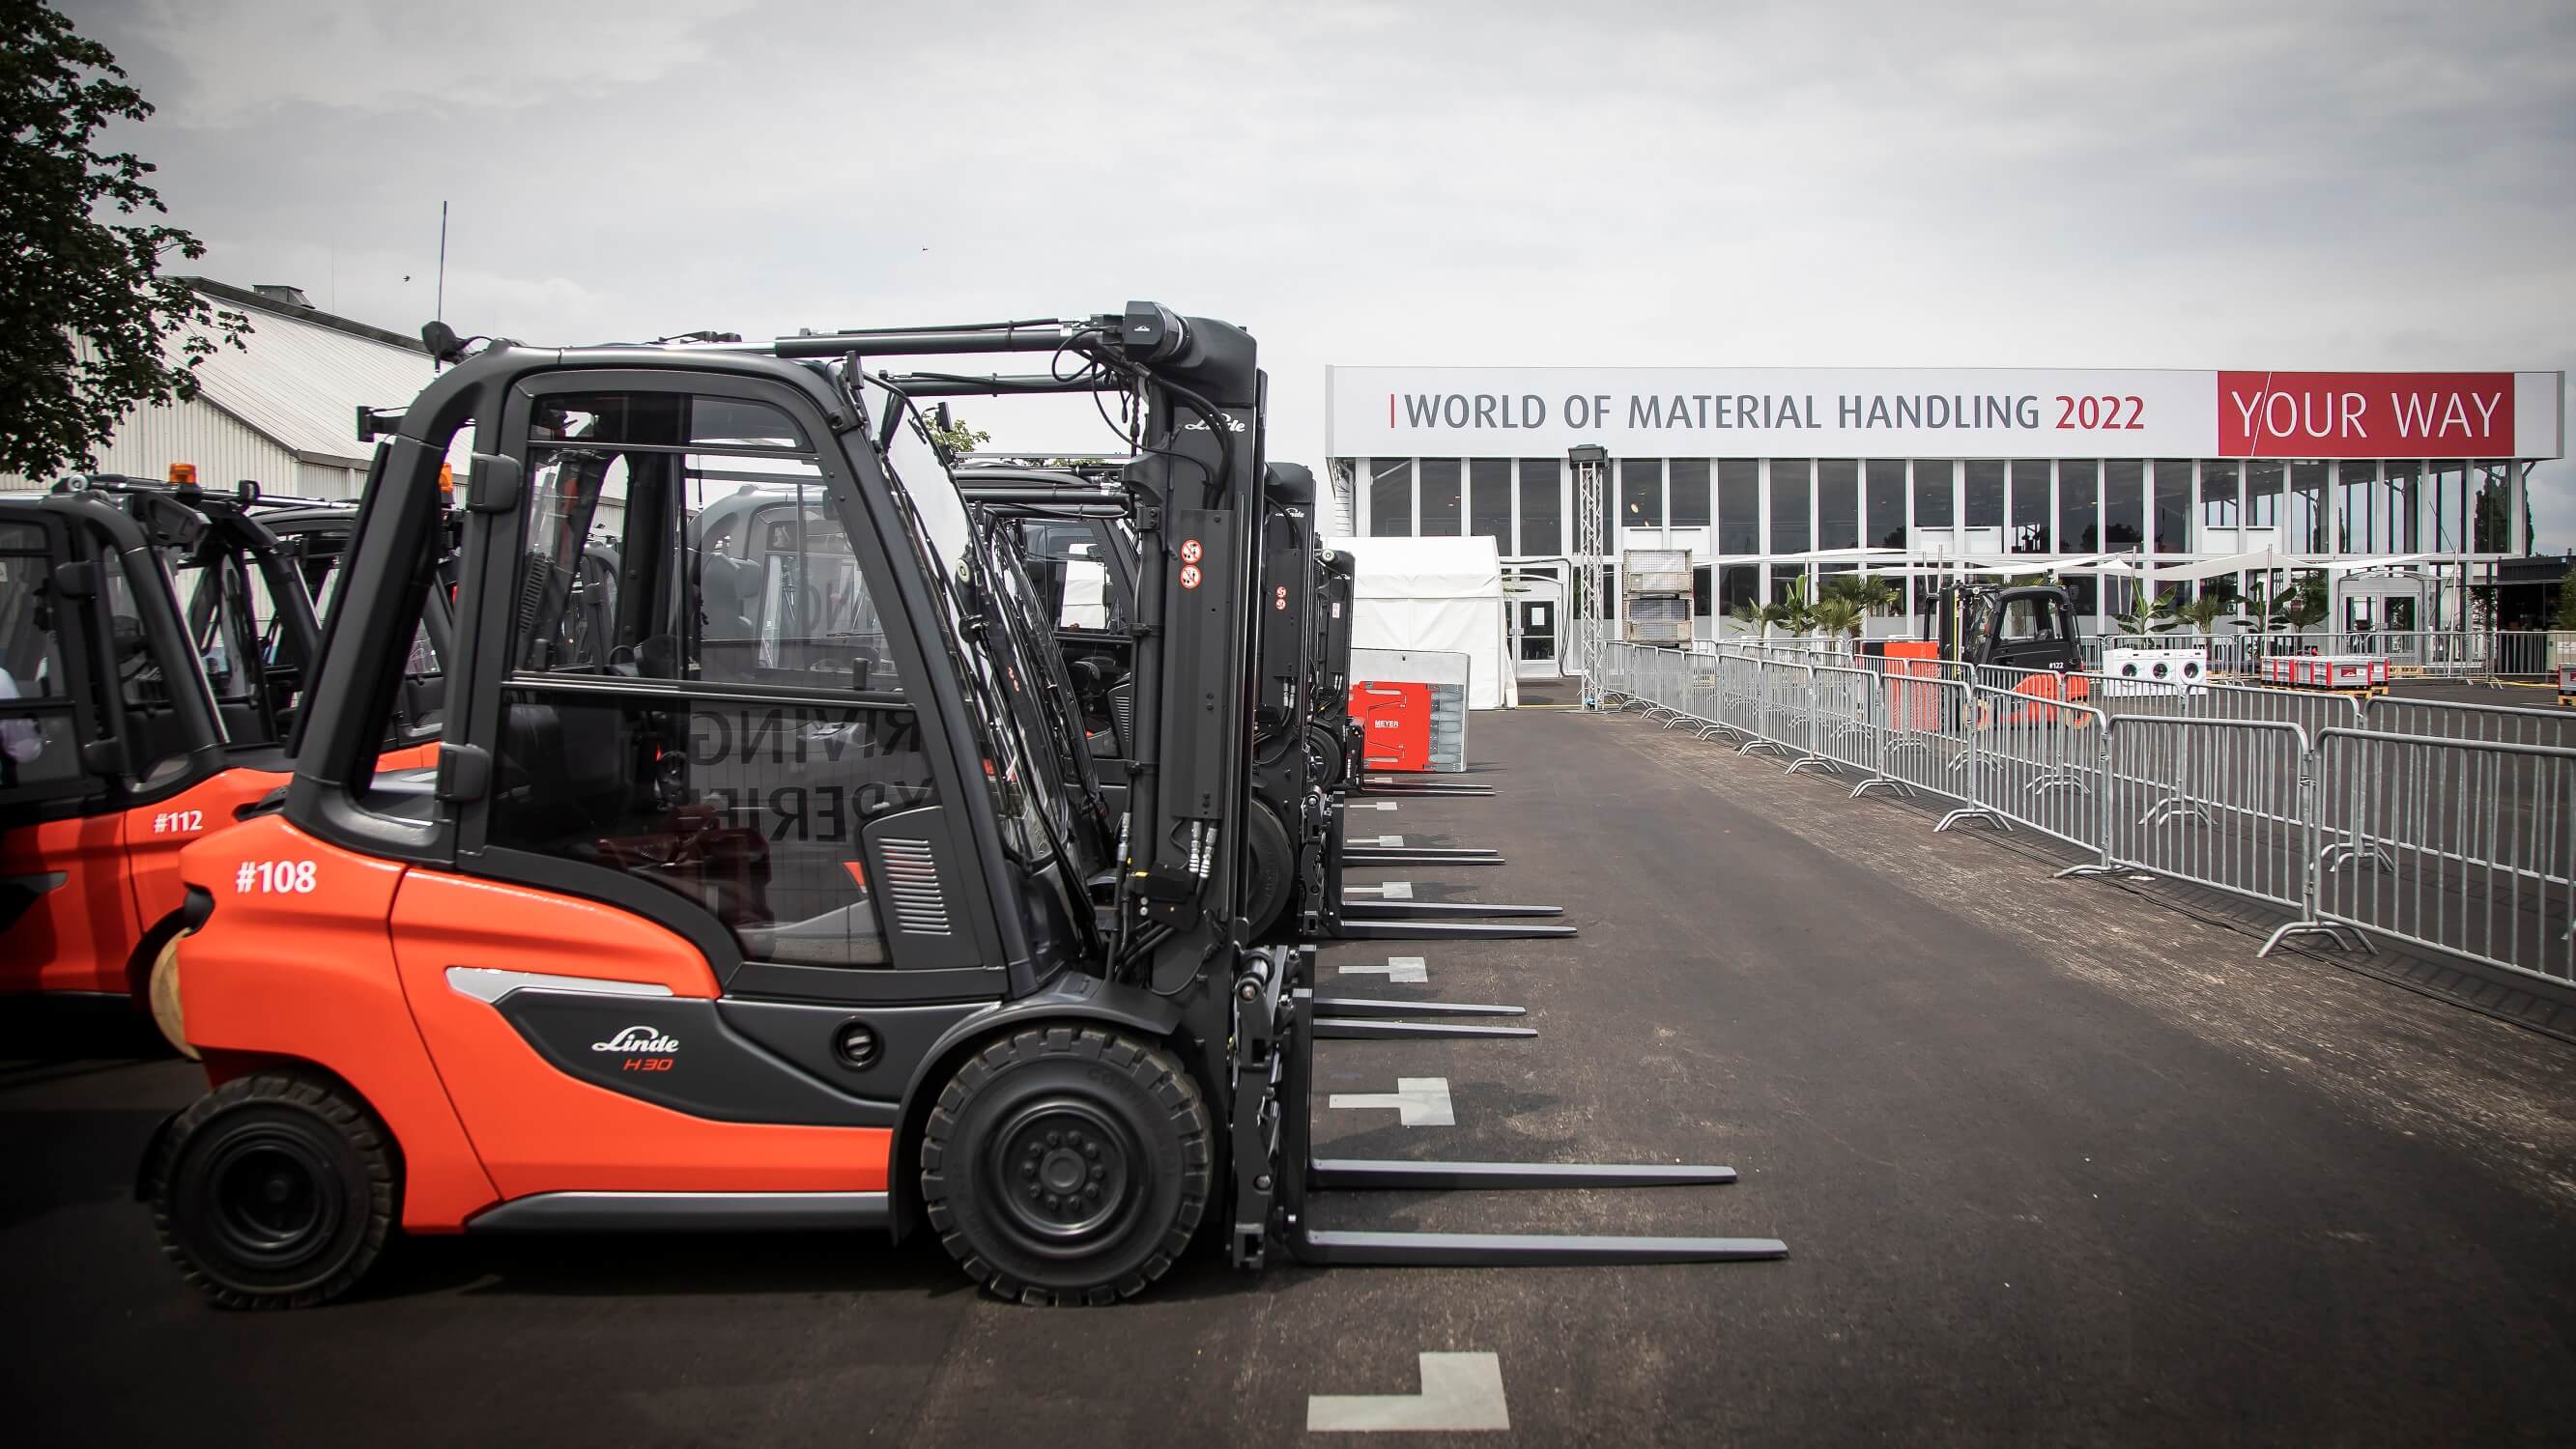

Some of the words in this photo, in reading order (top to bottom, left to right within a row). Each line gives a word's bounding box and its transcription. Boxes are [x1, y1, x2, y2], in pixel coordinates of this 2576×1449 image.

[1404, 393, 1546, 429] WORLD
[1563, 394, 1612, 429] OF
[1628, 394, 1822, 429] MATERIAL
[1839, 394, 2040, 430] HANDLING
[2055, 395, 2145, 430] 2022
[2231, 391, 2367, 438] YOUR
[2390, 392, 2503, 438] WAY
[154, 810, 203, 834] #112
[235, 860, 318, 894] #108
[591, 1025, 680, 1053] Linde
